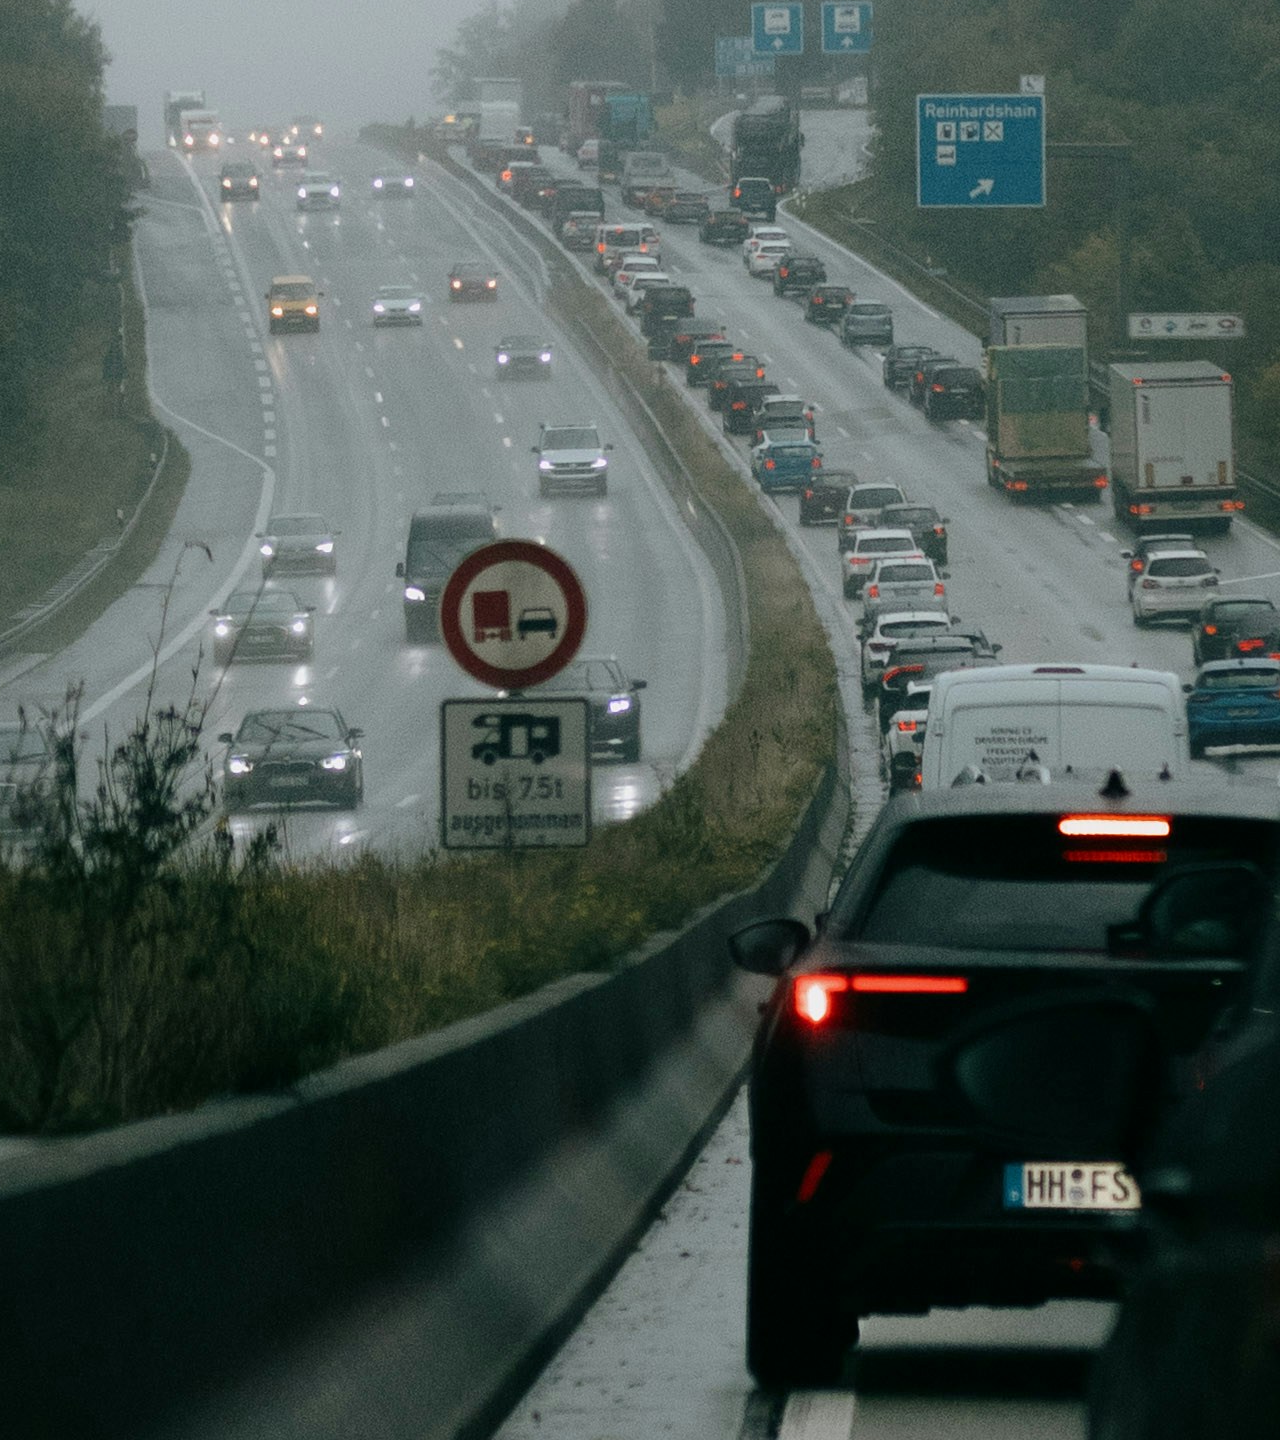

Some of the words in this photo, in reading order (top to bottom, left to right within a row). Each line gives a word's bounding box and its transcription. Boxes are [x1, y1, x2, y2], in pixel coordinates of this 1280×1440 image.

[925, 103, 1036, 118] Reinhardshain
[467, 777, 507, 800] bis
[1027, 1169, 1065, 1202] HH
[1091, 1169, 1131, 1202] FS
